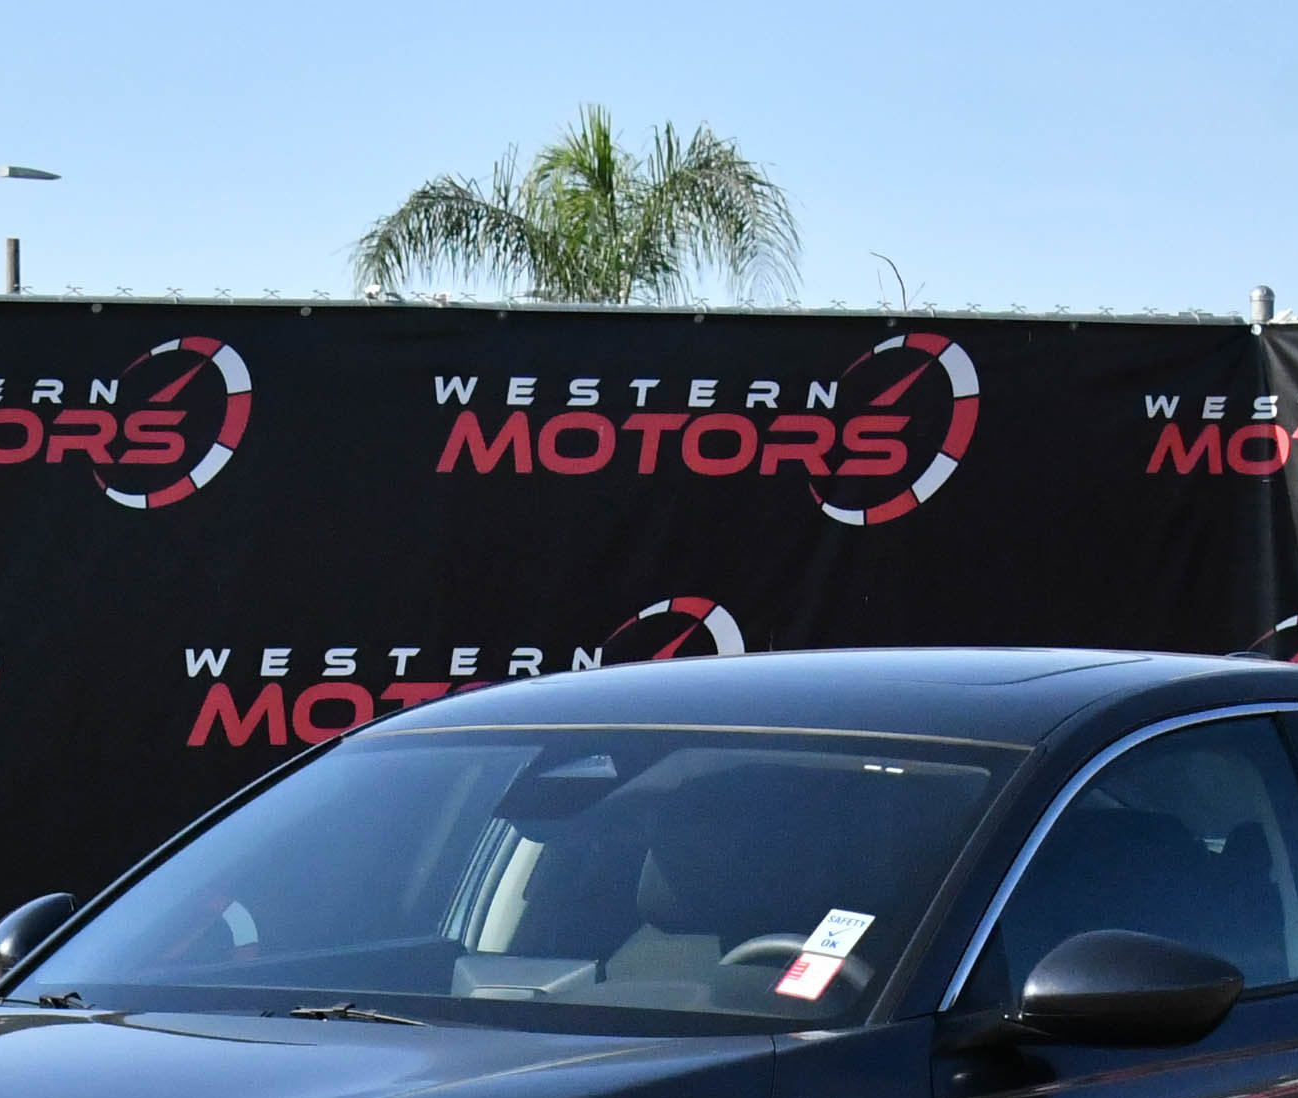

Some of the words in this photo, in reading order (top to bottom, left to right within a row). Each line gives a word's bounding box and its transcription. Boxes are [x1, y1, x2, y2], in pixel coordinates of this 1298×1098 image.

[434, 376, 838, 409] WESTERN
[436, 410, 910, 476] MOTORS
[185, 647, 603, 677] WESTERN
[828, 915, 865, 928] SAFETY
[820, 938, 839, 949] OK
